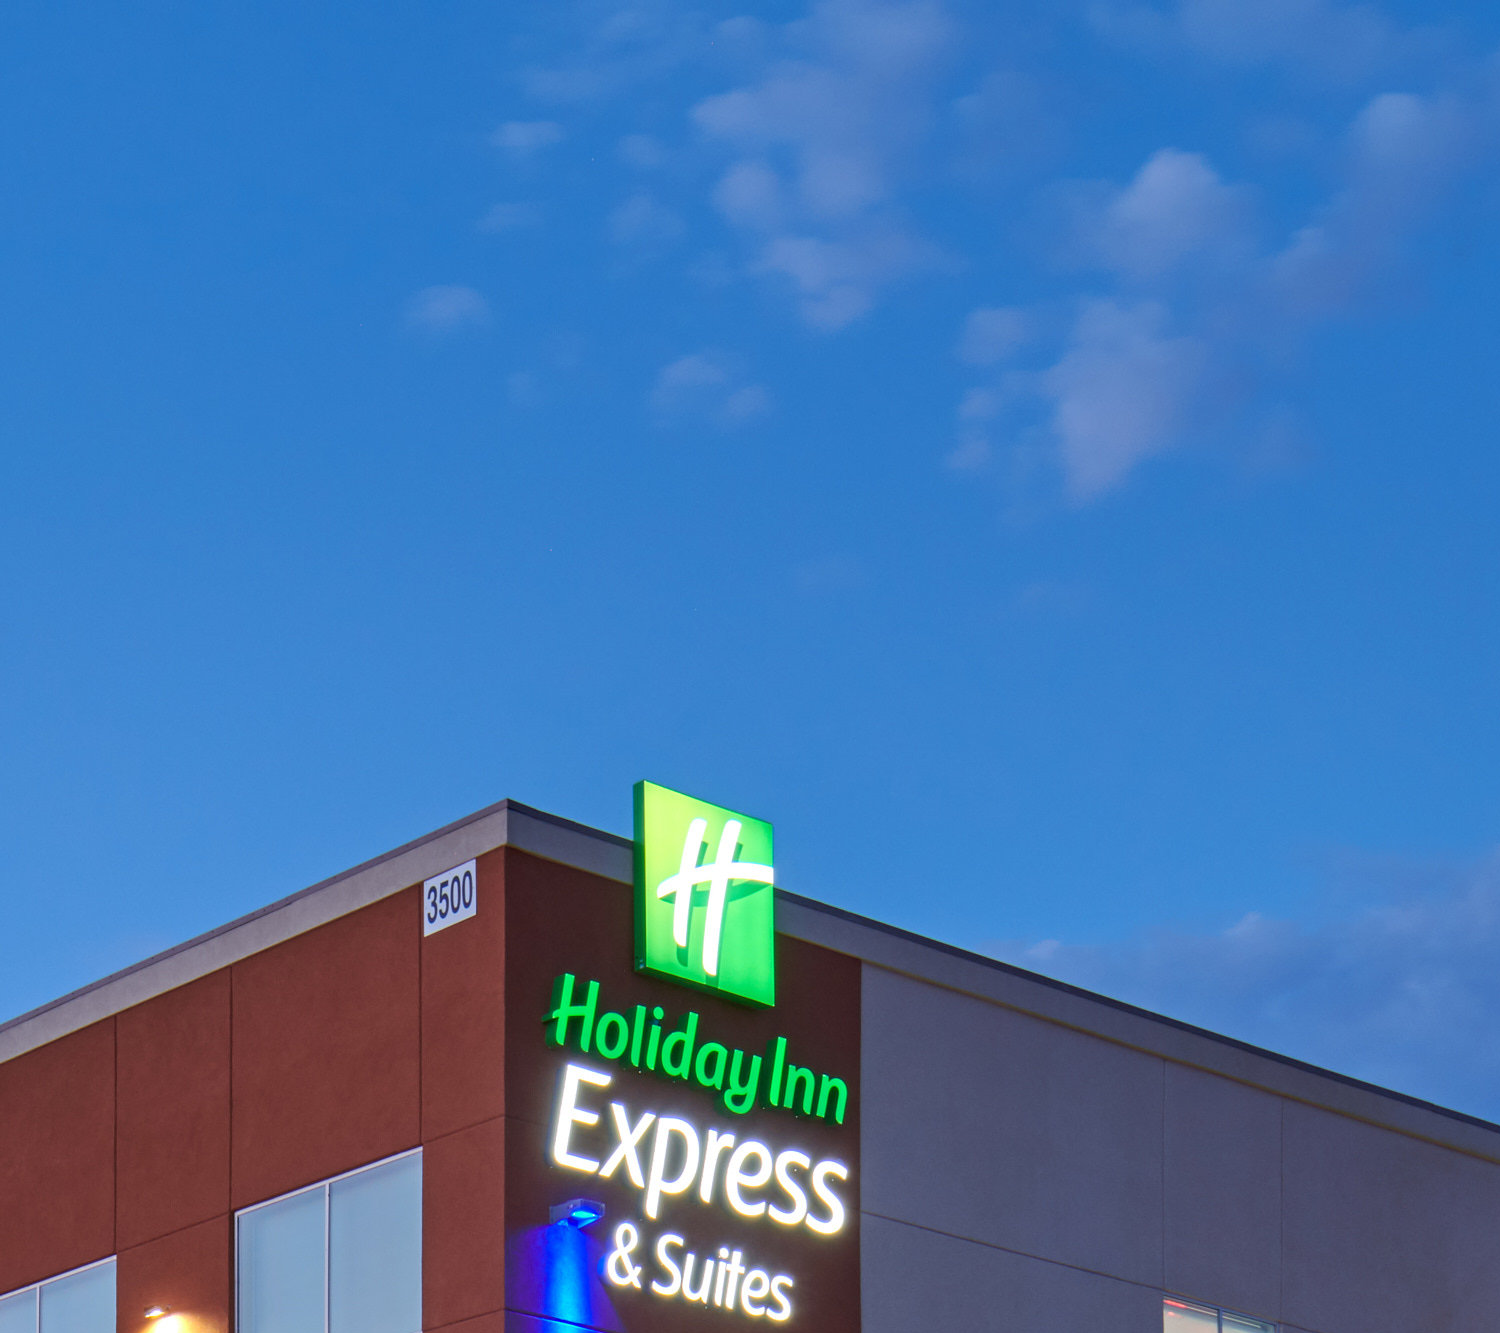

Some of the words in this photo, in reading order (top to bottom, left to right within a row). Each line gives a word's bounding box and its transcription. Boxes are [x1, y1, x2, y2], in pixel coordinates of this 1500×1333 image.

[427, 870, 473, 924] 3500
[545, 973, 762, 1115] Holiday
[769, 1036, 848, 1125] Inn
[552, 1063, 848, 1235] Express
[605, 1221, 642, 1288] &
[652, 1233, 795, 1322] Suites
